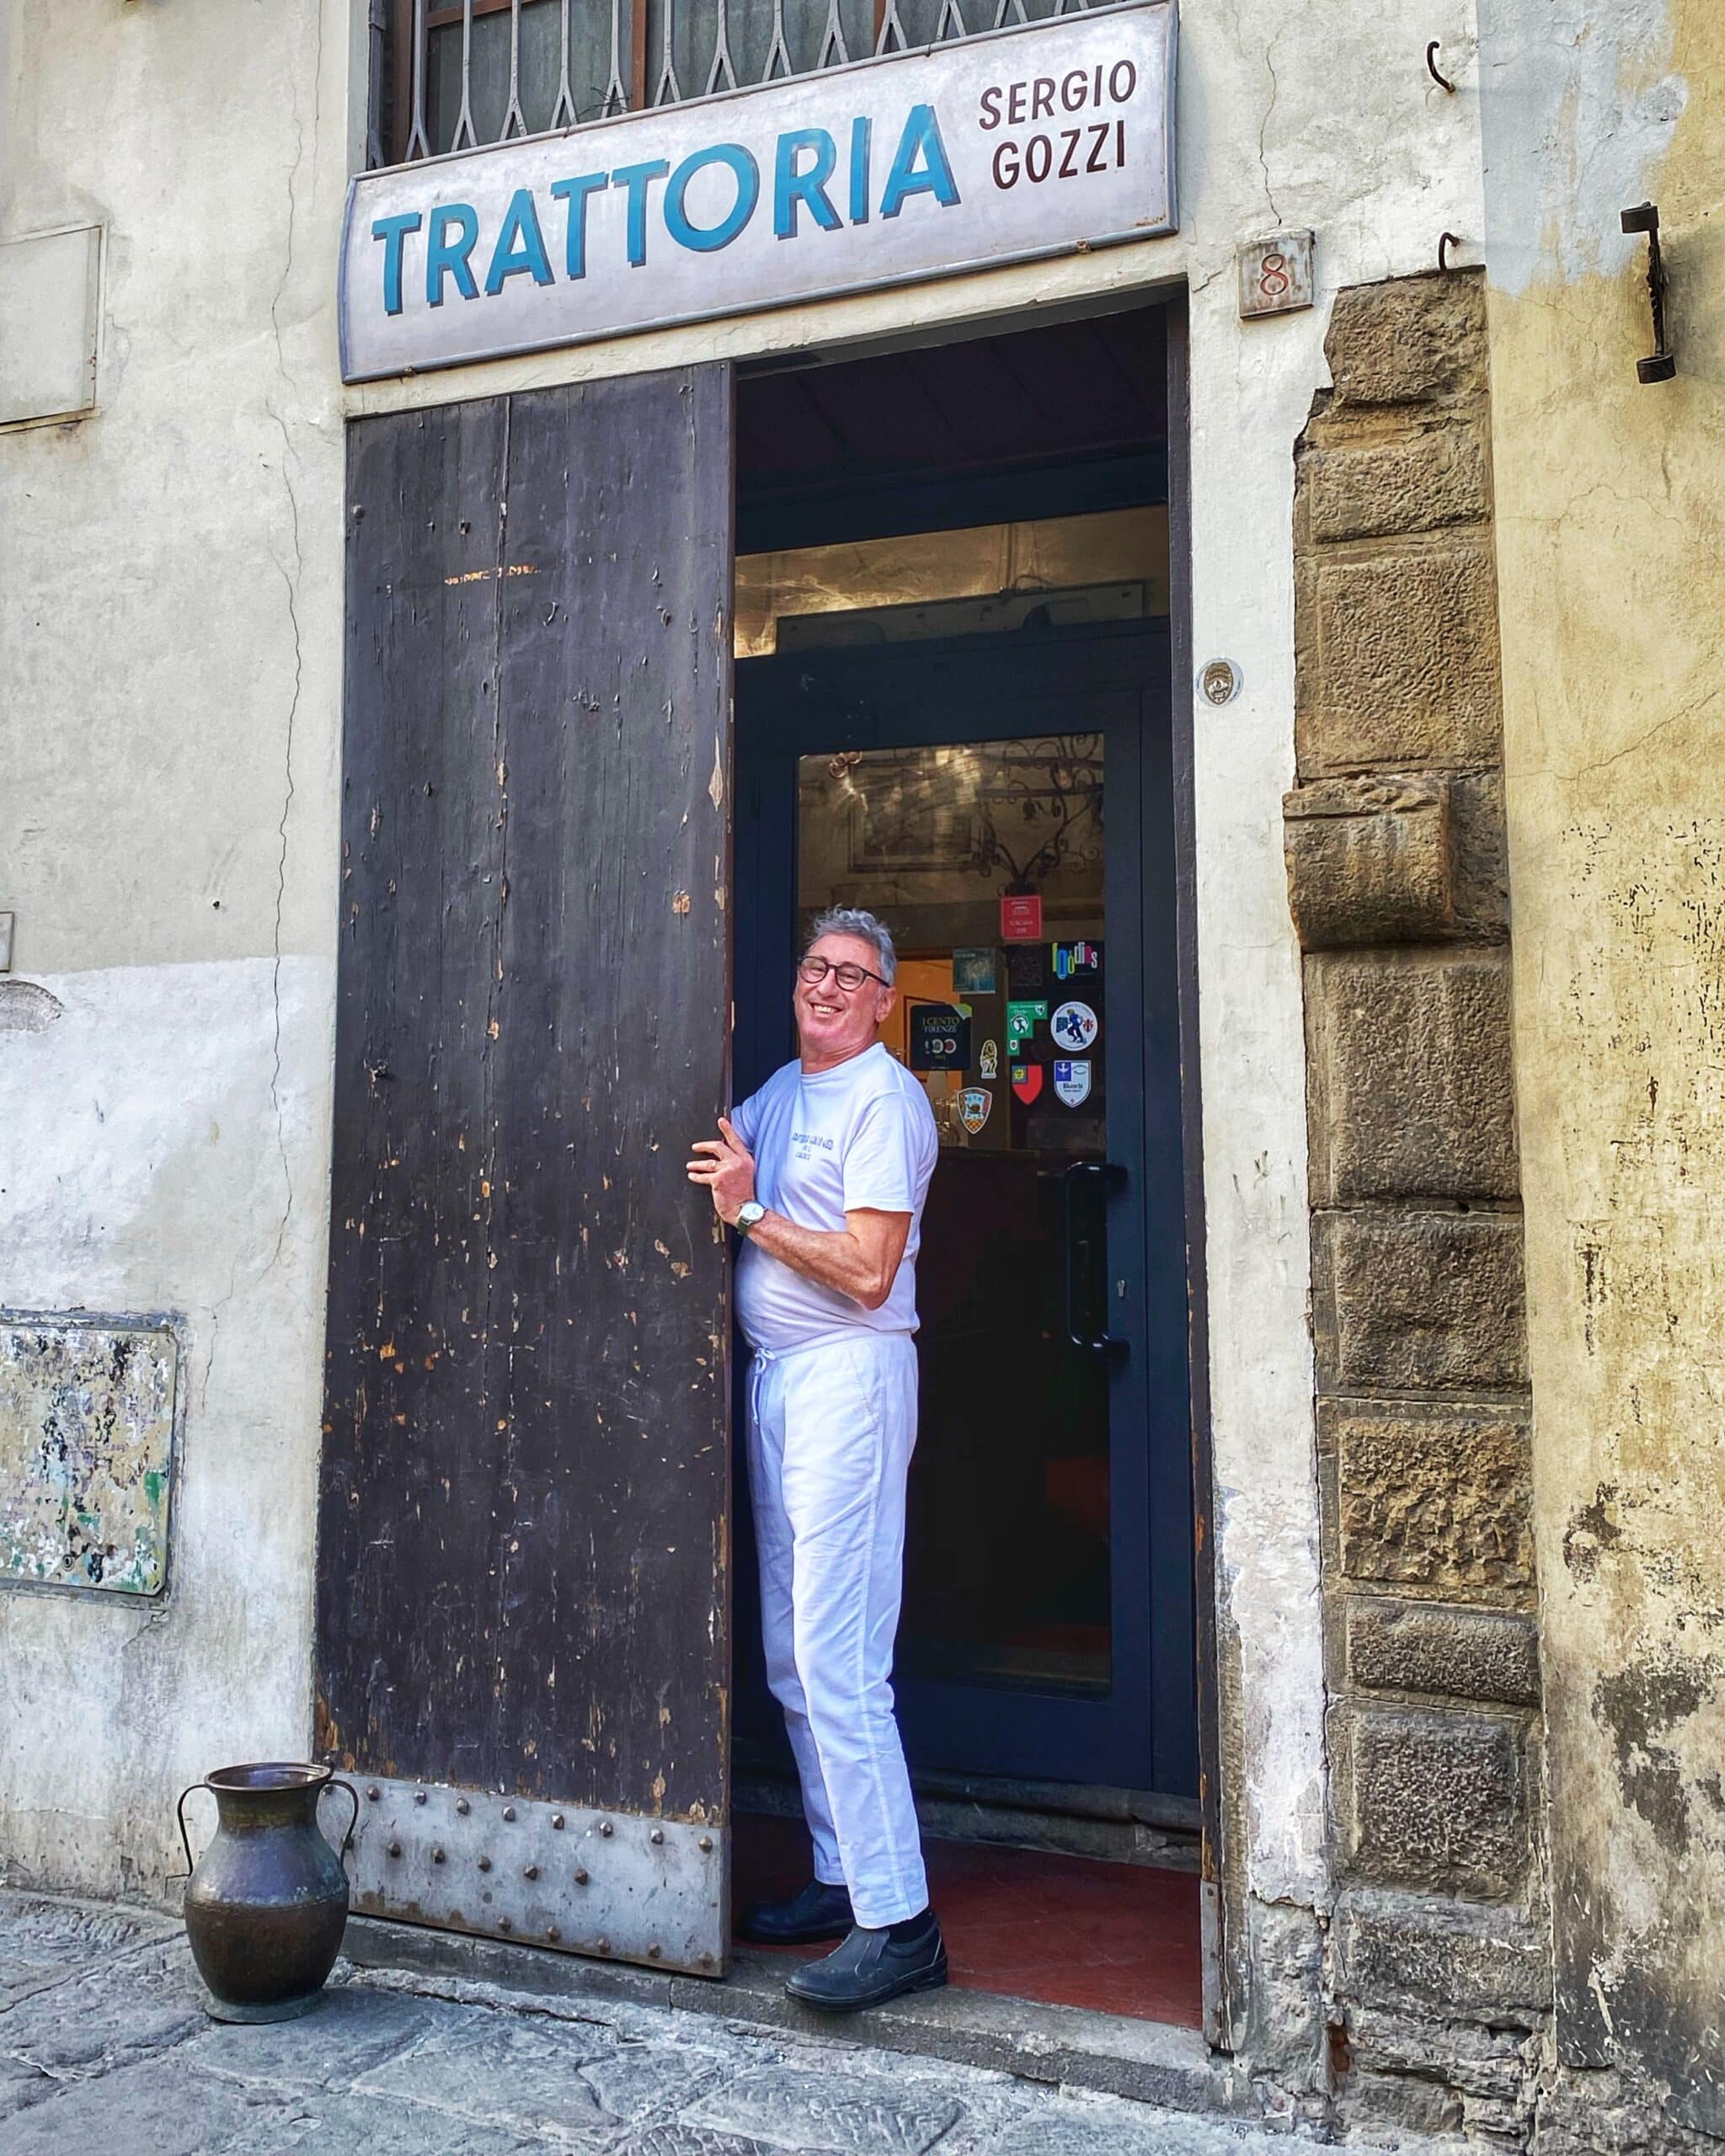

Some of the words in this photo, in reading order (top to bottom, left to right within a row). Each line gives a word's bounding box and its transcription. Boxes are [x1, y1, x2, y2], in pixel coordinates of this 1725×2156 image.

[979, 59, 1138, 131] SERGIO
[992, 118, 1127, 190] GOZZI
[371, 103, 962, 317] TRATTORIA
[1260, 253, 1290, 296] 8
[927, 1017, 960, 1026] CENTO
